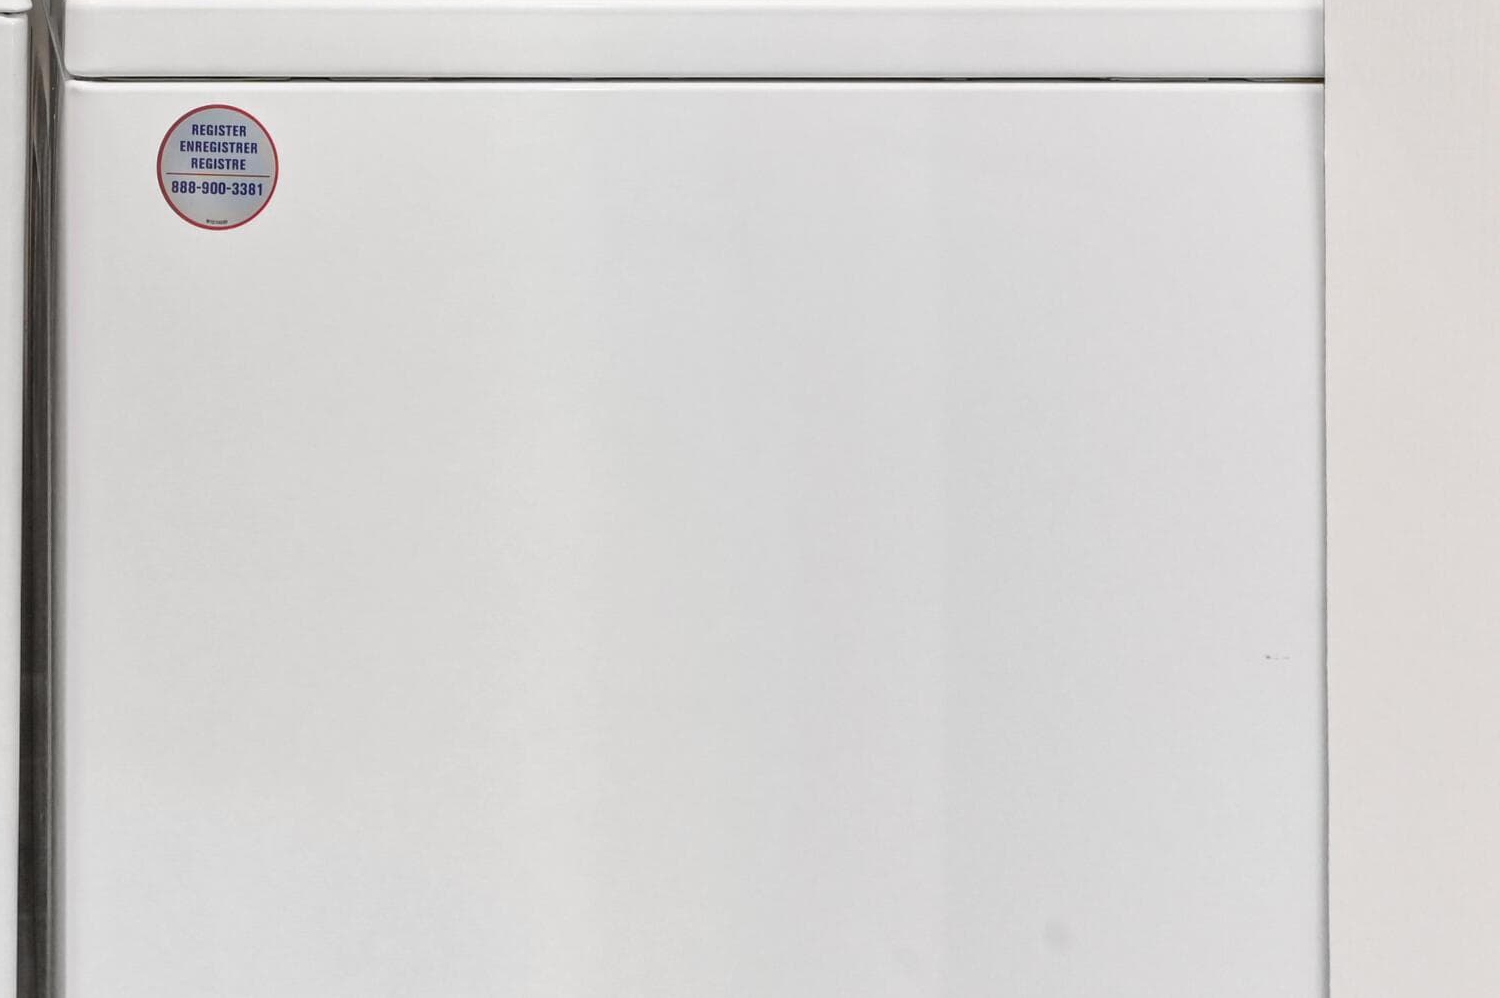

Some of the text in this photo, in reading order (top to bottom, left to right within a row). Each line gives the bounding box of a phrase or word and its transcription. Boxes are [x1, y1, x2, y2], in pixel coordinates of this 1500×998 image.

[192, 124, 247, 137] REGISTER
[180, 141, 258, 154] ENREGISTRER
[191, 157, 246, 170] REGISTRE
[171, 180, 262, 196] 888-900-3381
